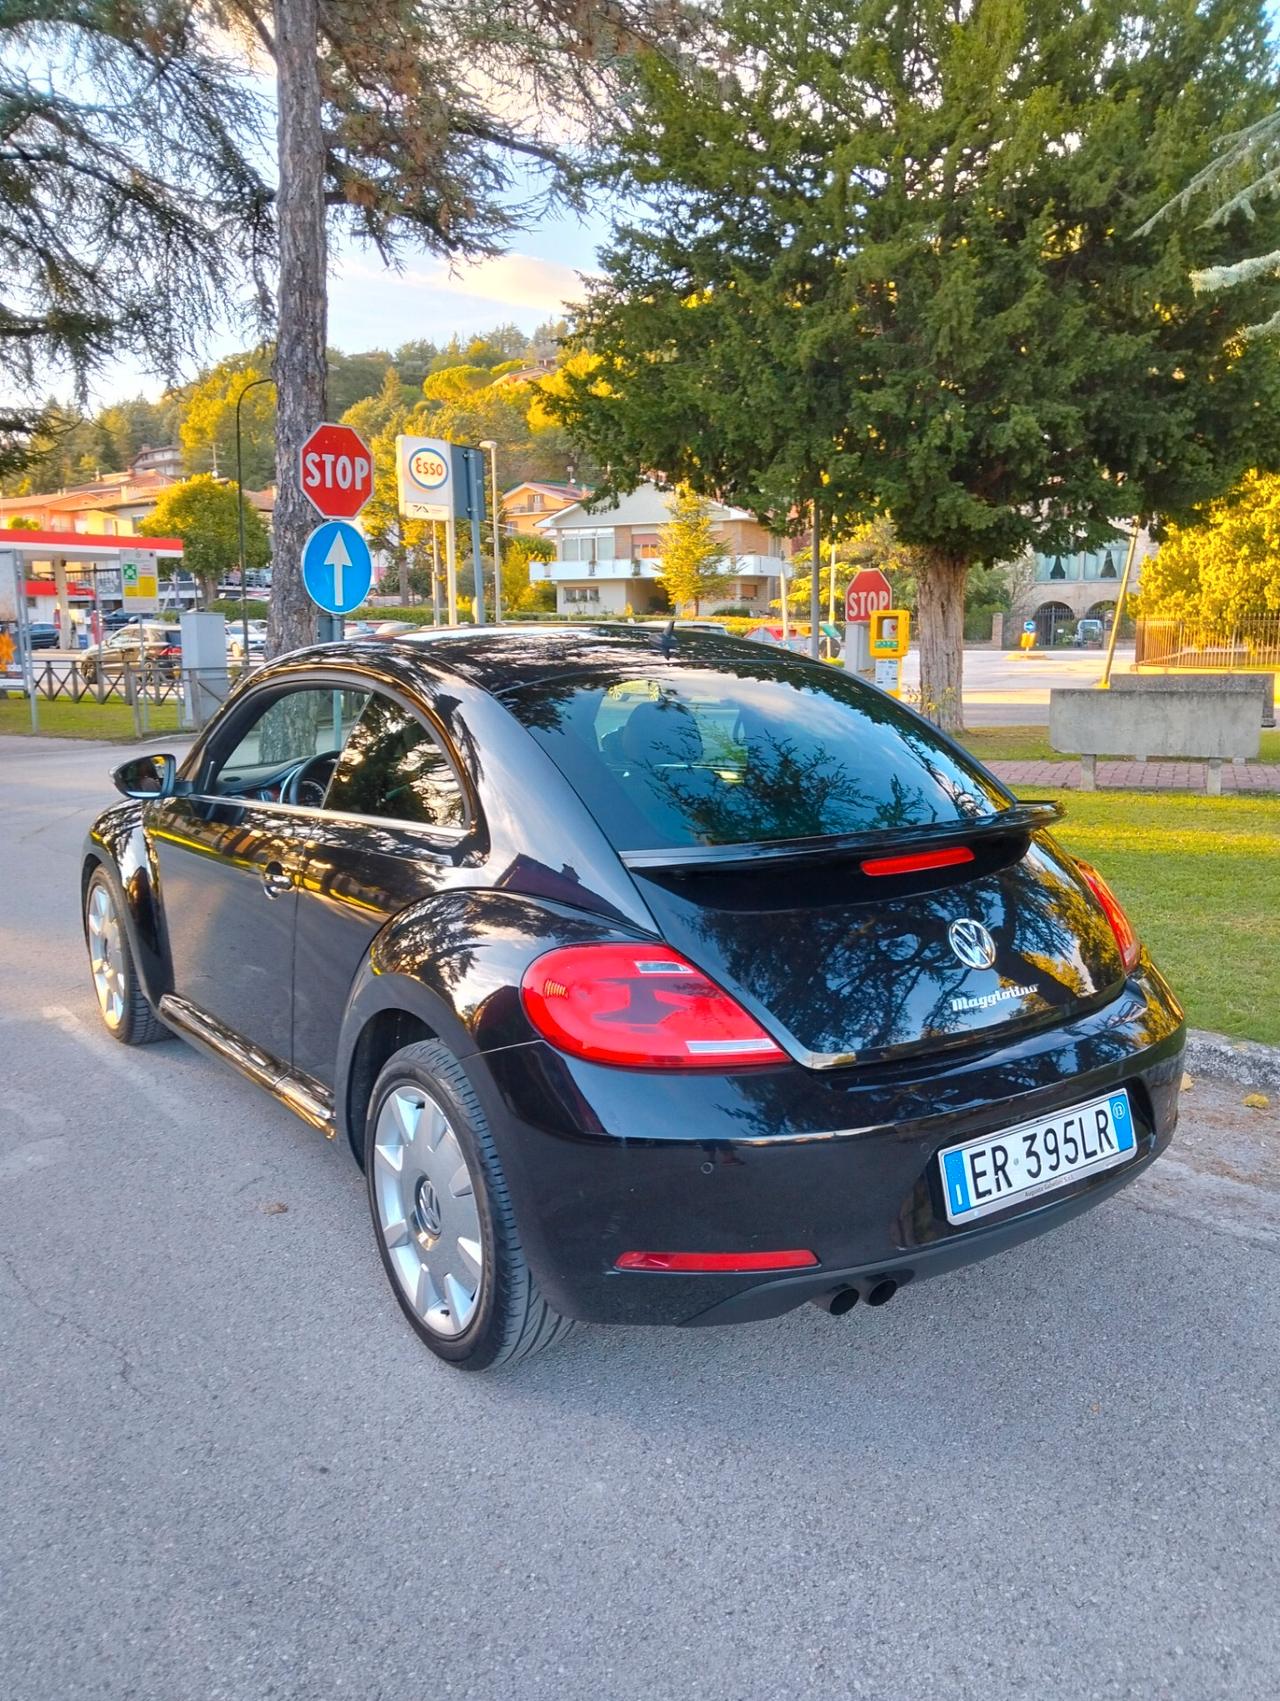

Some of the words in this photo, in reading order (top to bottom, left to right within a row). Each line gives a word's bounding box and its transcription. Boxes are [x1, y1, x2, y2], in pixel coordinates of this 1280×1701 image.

[305, 452, 369, 490] STOP
[415, 457, 443, 477] Esso
[848, 591, 889, 617] STOP
[950, 984, 1039, 1011] Maggiolino
[969, 1144, 1013, 1200] ER
[1022, 1109, 1115, 1178] 395LR
